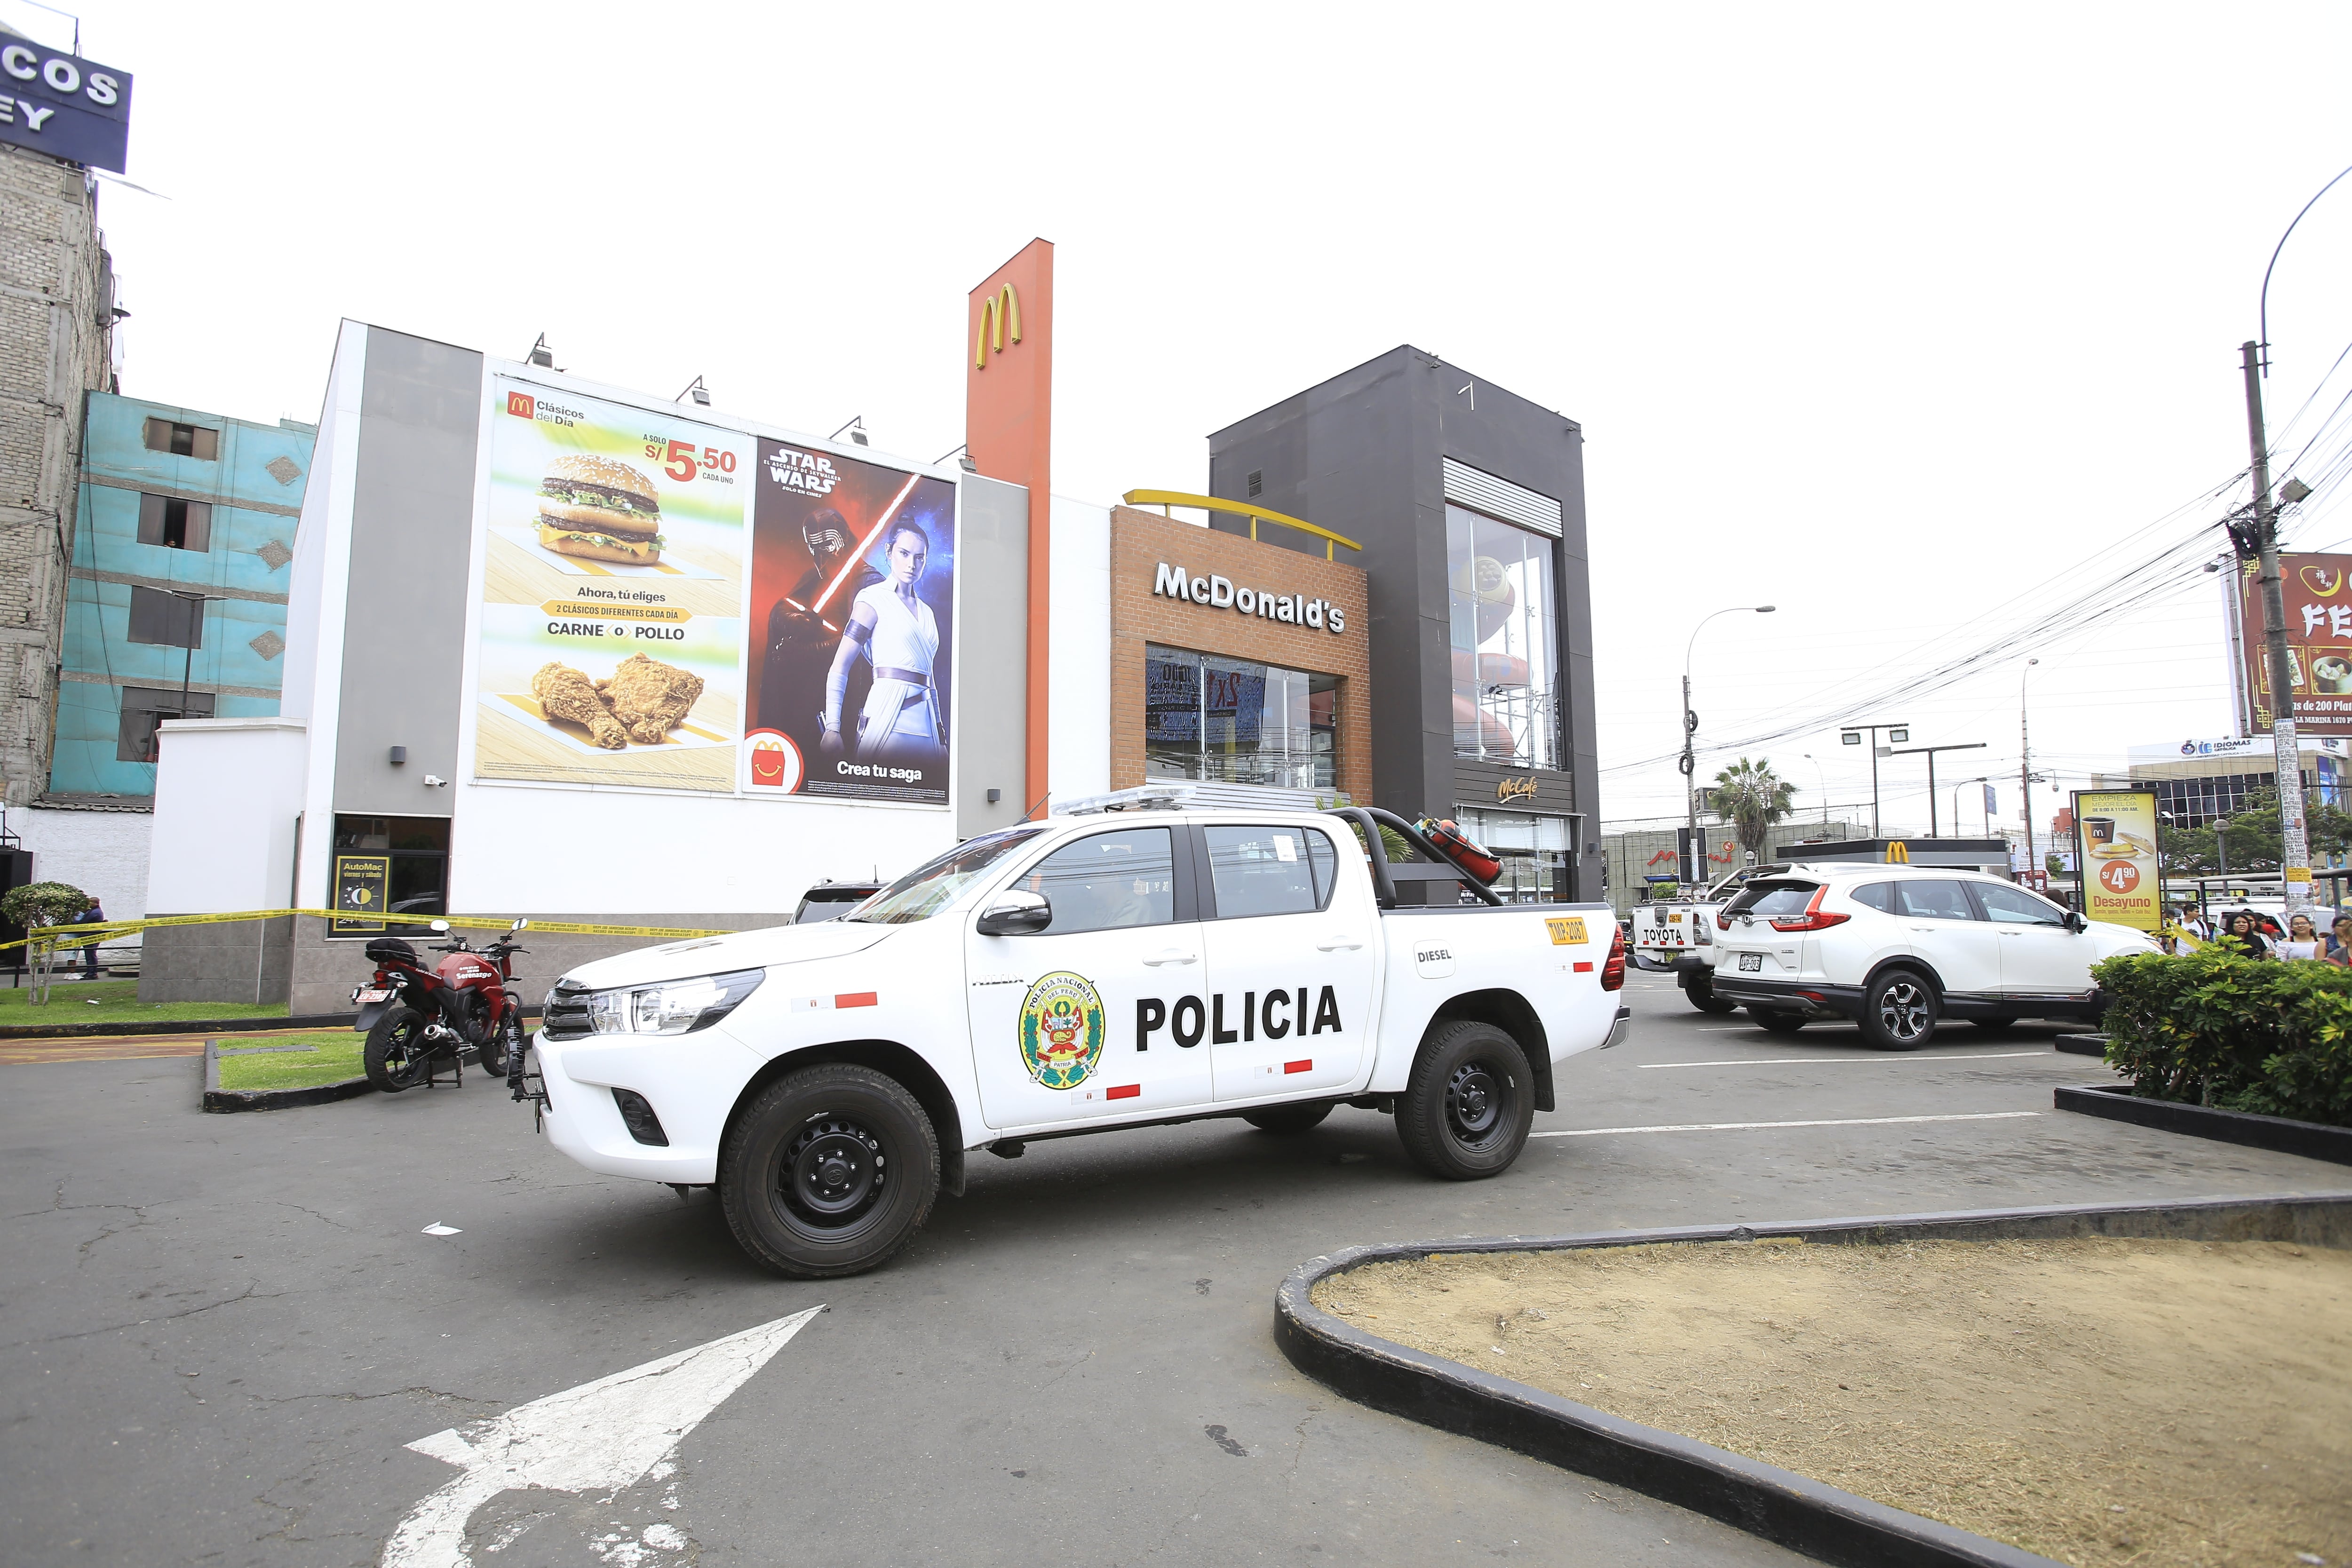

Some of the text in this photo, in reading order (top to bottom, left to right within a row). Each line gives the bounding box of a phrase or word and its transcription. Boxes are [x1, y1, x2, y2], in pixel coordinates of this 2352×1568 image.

[537, 400, 585, 420] Clásicos
[536, 411, 574, 428] del Día
[649, 435, 667, 445] SOLO
[645, 444, 663, 462] S/
[770, 448, 836, 475] STAR
[702, 472, 733, 485] CADA UNO
[770, 466, 835, 493] WARS
[772, 462, 798, 471] ASCENSO
[810, 470, 842, 482] SKYWALKER
[577, 587, 666, 603] Ahora, tú eliges
[1153, 561, 1345, 634] McDonald's
[563, 604, 599, 615] CLÁSICOS
[601, 606, 644, 618] DIFERENTES
[646, 609, 665, 618] CADA
[666, 609, 678, 619] DÍA
[548, 622, 604, 637] CARNE
[636, 627, 684, 640] POLLO
[2303, 700, 2314, 711] de
[2315, 700, 2332, 711] 200
[2334, 700, 2352, 711] Plat
[2214, 740, 2251, 748] IDIOMAS
[837, 761, 922, 783] Crea tu saga
[2093, 896, 2151, 909] Desayuno
[1644, 929, 1682, 941] TOYOTA
[1417, 949, 1452, 963] DIESEL
[1029, 977, 1094, 1009] POLICIA NACIONAL
[1047, 988, 1078, 1001] DEL PERÚ
[1136, 985, 1342, 1052] POLICIA
[1038, 1052, 1050, 1061] DIOS
